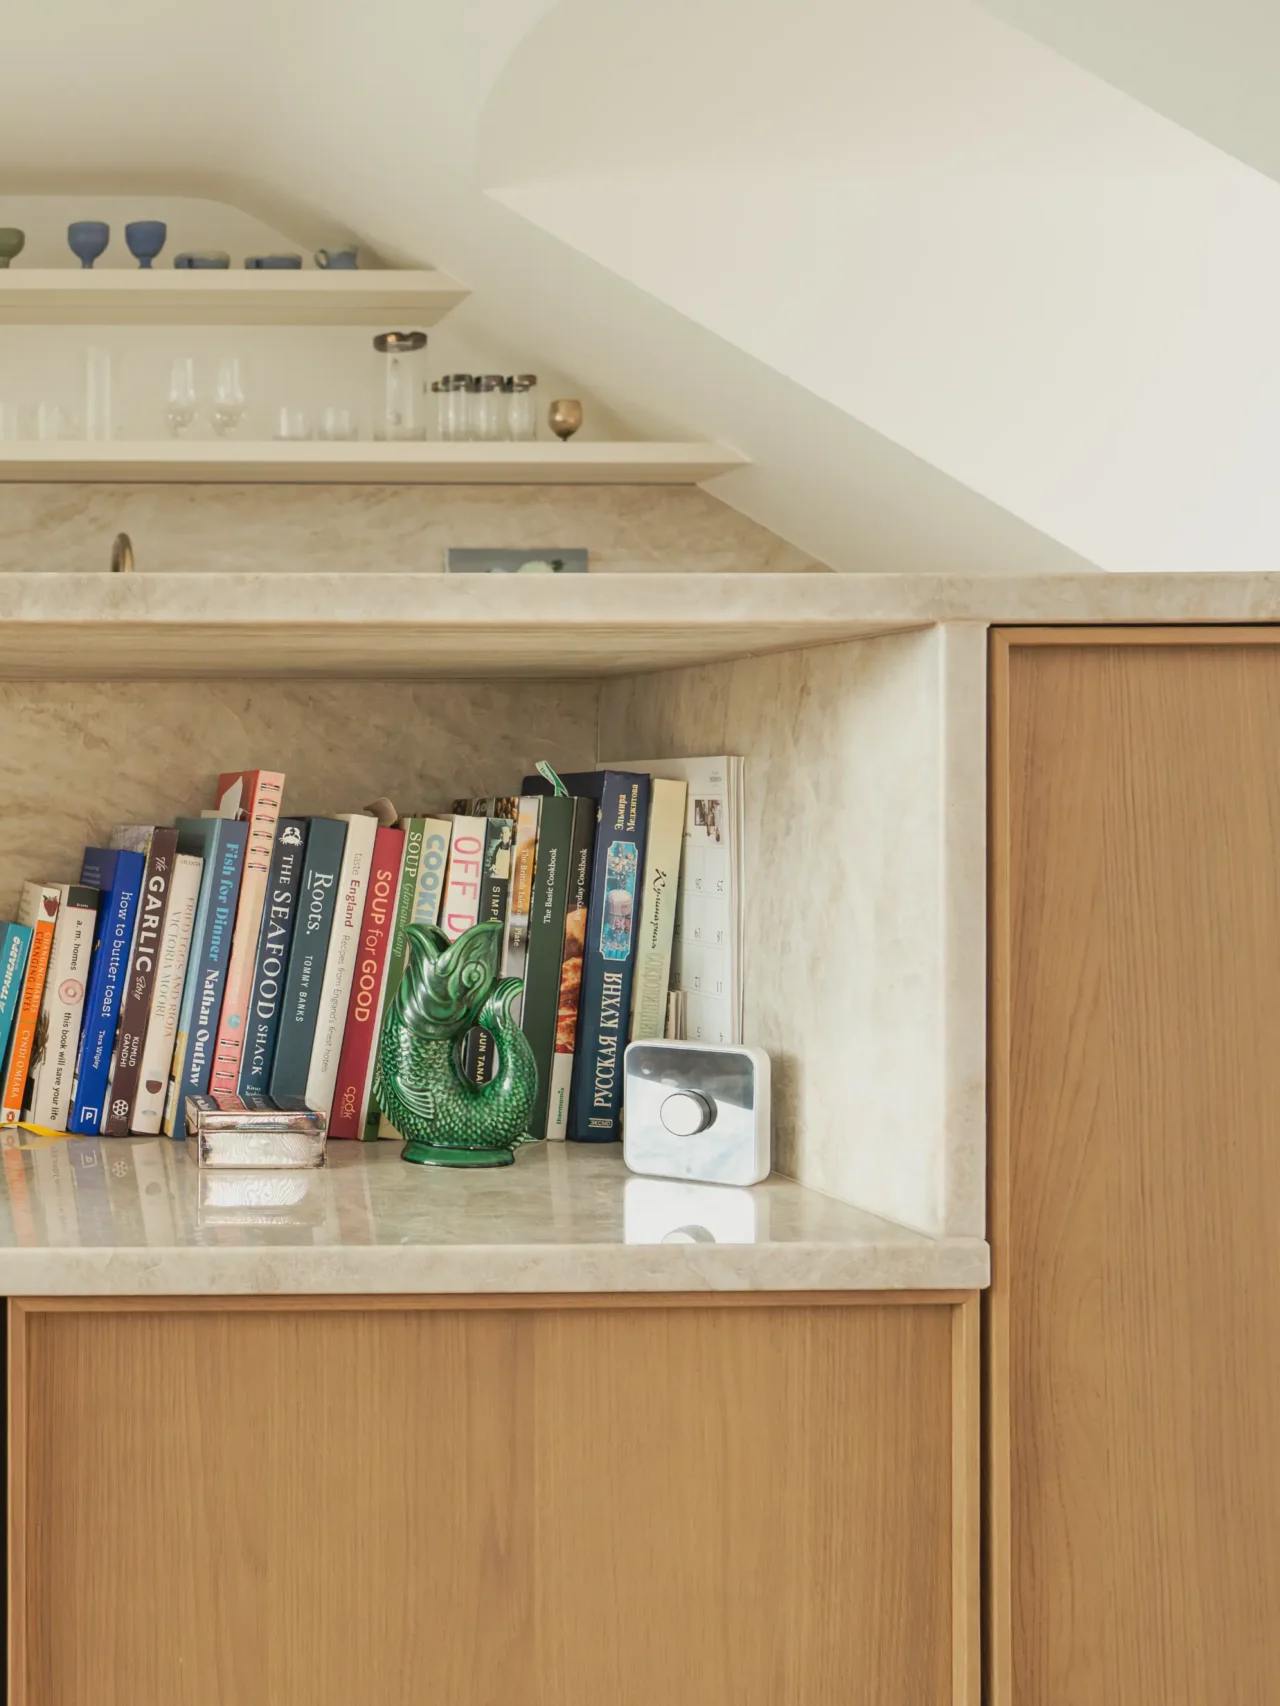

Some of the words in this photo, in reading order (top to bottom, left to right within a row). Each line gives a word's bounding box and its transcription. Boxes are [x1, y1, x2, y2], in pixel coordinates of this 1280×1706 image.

[613, 793, 628, 831] Эльмира
[626, 783, 640, 833] Меджитова
[153, 856, 168, 872] The
[224, 841, 240, 876] Fish
[278, 854, 295, 885] THE
[351, 852, 364, 876] taste
[404, 830, 423, 878] SOUP
[451, 836, 482, 900] OFF
[520, 847, 529, 864] The
[547, 847, 558, 887] Cookbook
[577, 847, 589, 886] Cookbook
[219, 876, 235, 902] for
[518, 864, 528, 890] British
[117, 891, 133, 921] how
[306, 869, 334, 936] Roots.
[343, 879, 361, 928] England
[369, 869, 393, 925] SOUP
[516, 891, 526, 909] Isles
[545, 887, 555, 908] Basic
[573, 886, 587, 921] Everyday
[649, 867, 669, 950] Кулинарная
[76, 919, 83, 929] a.
[114, 923, 129, 937] to
[134, 875, 166, 973] GARLIC
[181, 896, 195, 933] FRIED
[542, 908, 553, 924] The
[74, 930, 82, 943] m.
[163, 910, 182, 970] VICTORIA
[208, 901, 230, 963] Dinner
[364, 926, 385, 958] for
[393, 931, 407, 959] soup
[513, 926, 523, 947] Plate
[26, 931, 43, 983] CHANGING
[37, 931, 52, 980] CHANGING
[70, 943, 82, 971] homes
[106, 939, 126, 982] butter
[174, 936, 188, 969] EGGS
[256, 888, 292, 1020] SEAFOOD
[336, 934, 351, 966] Recipes
[0, 936, 22, 1001] ТРАНСАЭРО
[301, 954, 314, 987] TOMMY
[333, 967, 347, 987] from
[22, 986, 35, 1012] LIVES
[30, 981, 45, 1014] HABITS
[101, 984, 117, 1018] toast
[133, 974, 149, 1002] Story
[169, 974, 184, 1000] AND
[197, 968, 220, 1026] Nathan
[354, 957, 378, 1023] GOOD
[599, 971, 623, 1030] КУХНЯ
[61, 1012, 72, 1028] this
[163, 1003, 179, 1039] RIOJA
[294, 991, 307, 1023] BANKS
[327, 988, 343, 1024] England's
[18, 1030, 32, 1059] CYNDI
[59, 1029, 71, 1050] book
[97, 1030, 106, 1045] Tara
[119, 1033, 132, 1068] GANDHI
[128, 1035, 140, 1067] KUMUD
[249, 1023, 270, 1076] SHACK
[324, 1025, 337, 1047] finest
[478, 1031, 487, 1054] JUN
[57, 1051, 68, 1066] will
[92, 1045, 104, 1070] Wigley
[190, 1026, 211, 1087] Outlaw
[320, 1048, 332, 1074] hotels
[593, 1034, 619, 1109] РУССКАЯ
[10, 1060, 26, 1099] O'MEARA
[53, 1067, 64, 1086] save
[50, 1087, 62, 1105] your
[556, 1087, 565, 1125] thermomix
[49, 1106, 60, 1121] life
[590, 1119, 612, 1127] ЭКСМО
